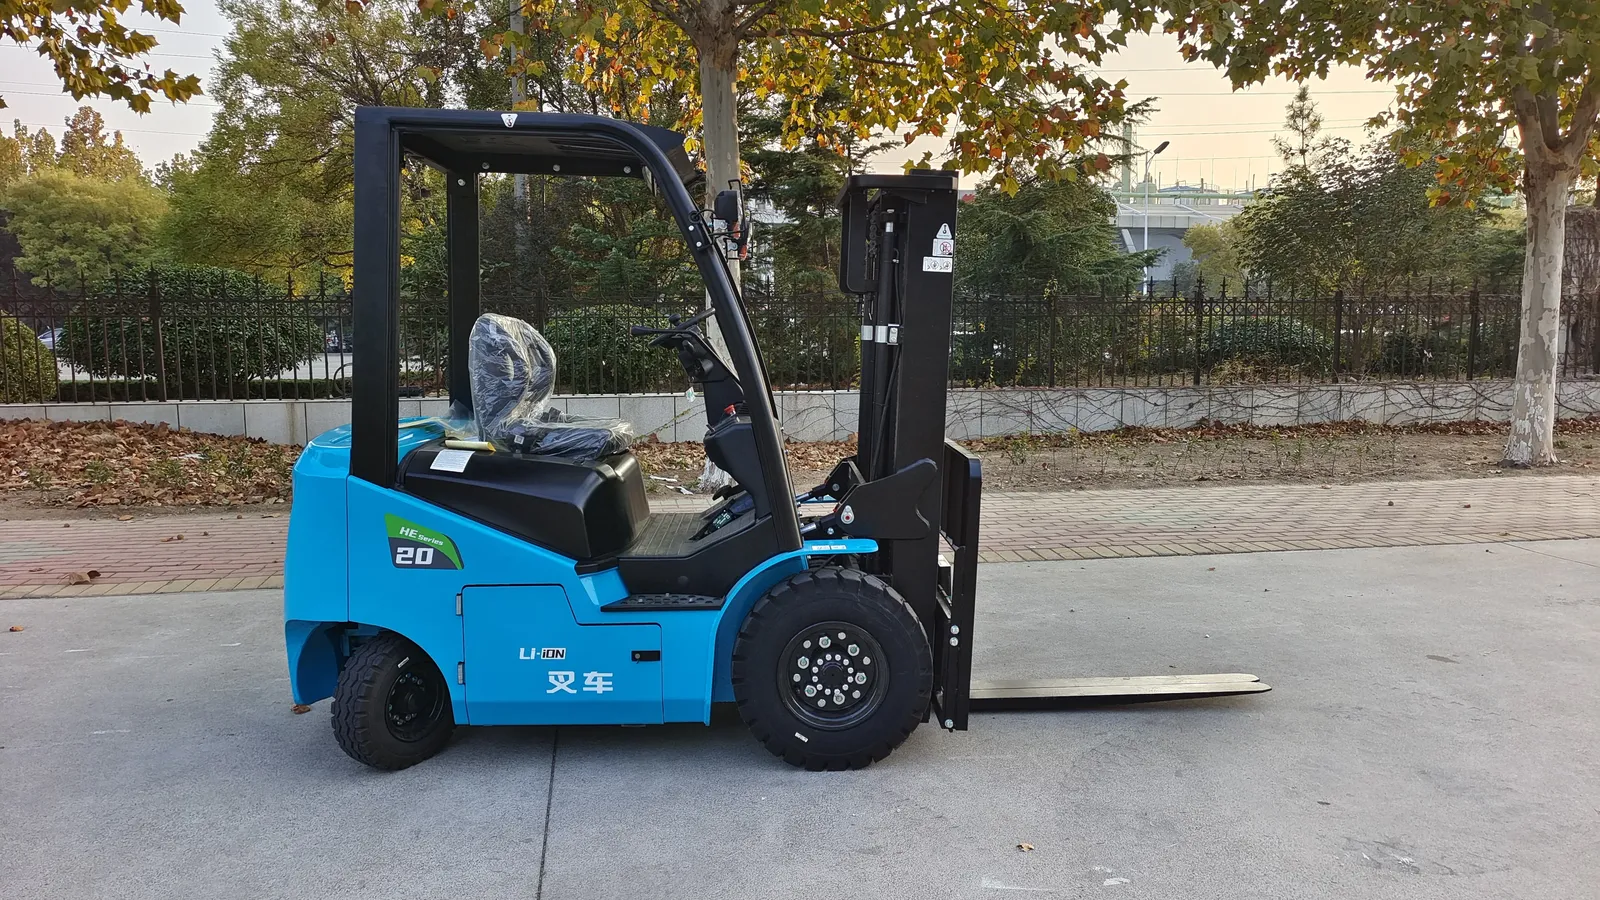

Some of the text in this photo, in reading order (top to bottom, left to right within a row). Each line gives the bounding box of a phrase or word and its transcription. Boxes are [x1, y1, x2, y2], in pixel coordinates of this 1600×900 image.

[399, 526, 444, 546] HE Series
[395, 547, 434, 565] 20
[546, 670, 613, 694] 叉车
